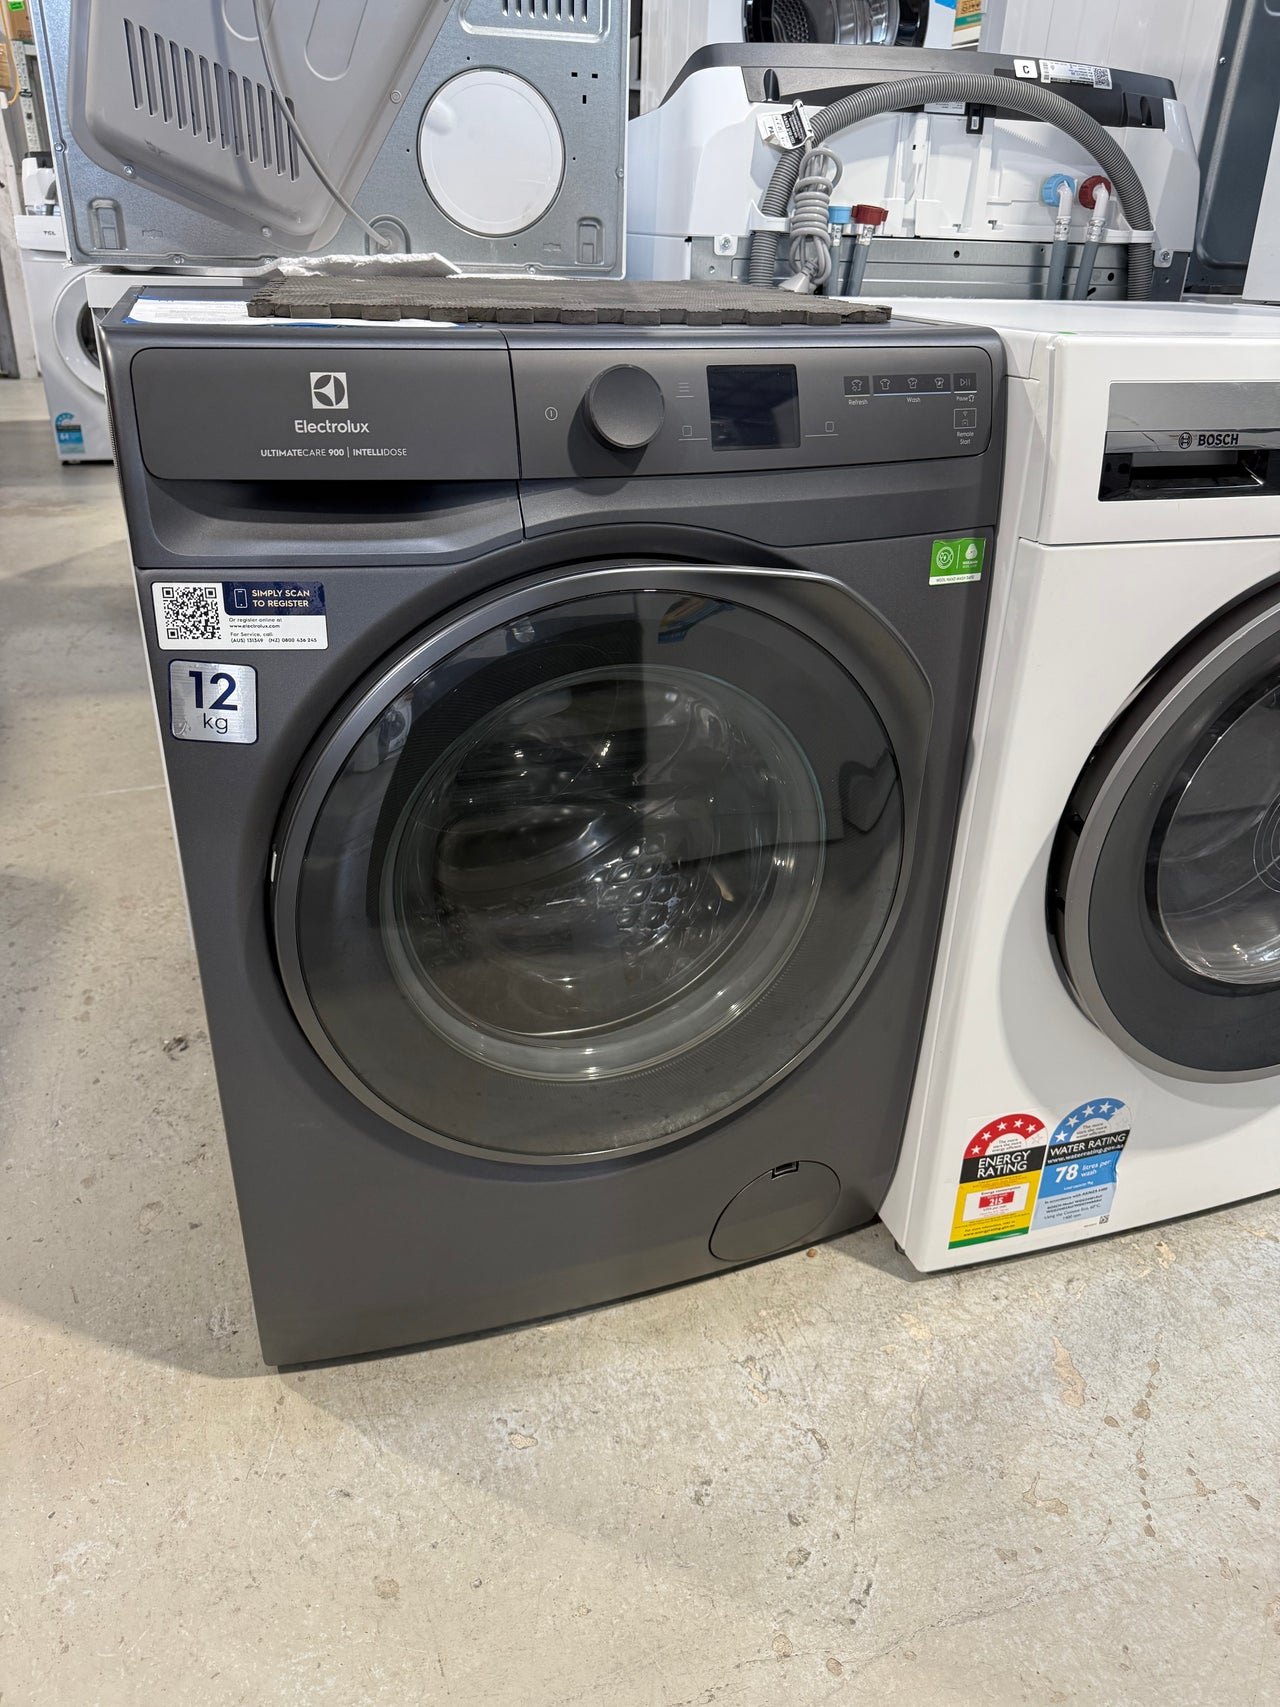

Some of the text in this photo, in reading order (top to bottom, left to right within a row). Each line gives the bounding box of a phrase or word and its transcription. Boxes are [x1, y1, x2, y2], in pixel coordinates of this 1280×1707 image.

[1022, 65, 1030, 74] C
[294, 419, 370, 433] Electrolux
[1198, 433, 1239, 447] BOSCH
[260, 448, 408, 457] ULTIMATECARE 900 INTELLIDOSE
[252, 589, 310, 597] SIMPLY SCAN
[189, 670, 238, 711] 12
[203, 712, 228, 734] kg
[1050, 1133, 1127, 1157] WATER RATING
[978, 1150, 1031, 1168] ENERGY
[977, 1161, 1028, 1178] RATING
[1055, 1164, 1079, 1183] 78
[1081, 1169, 1097, 1177] wash
[989, 1197, 1005, 1206] 215
